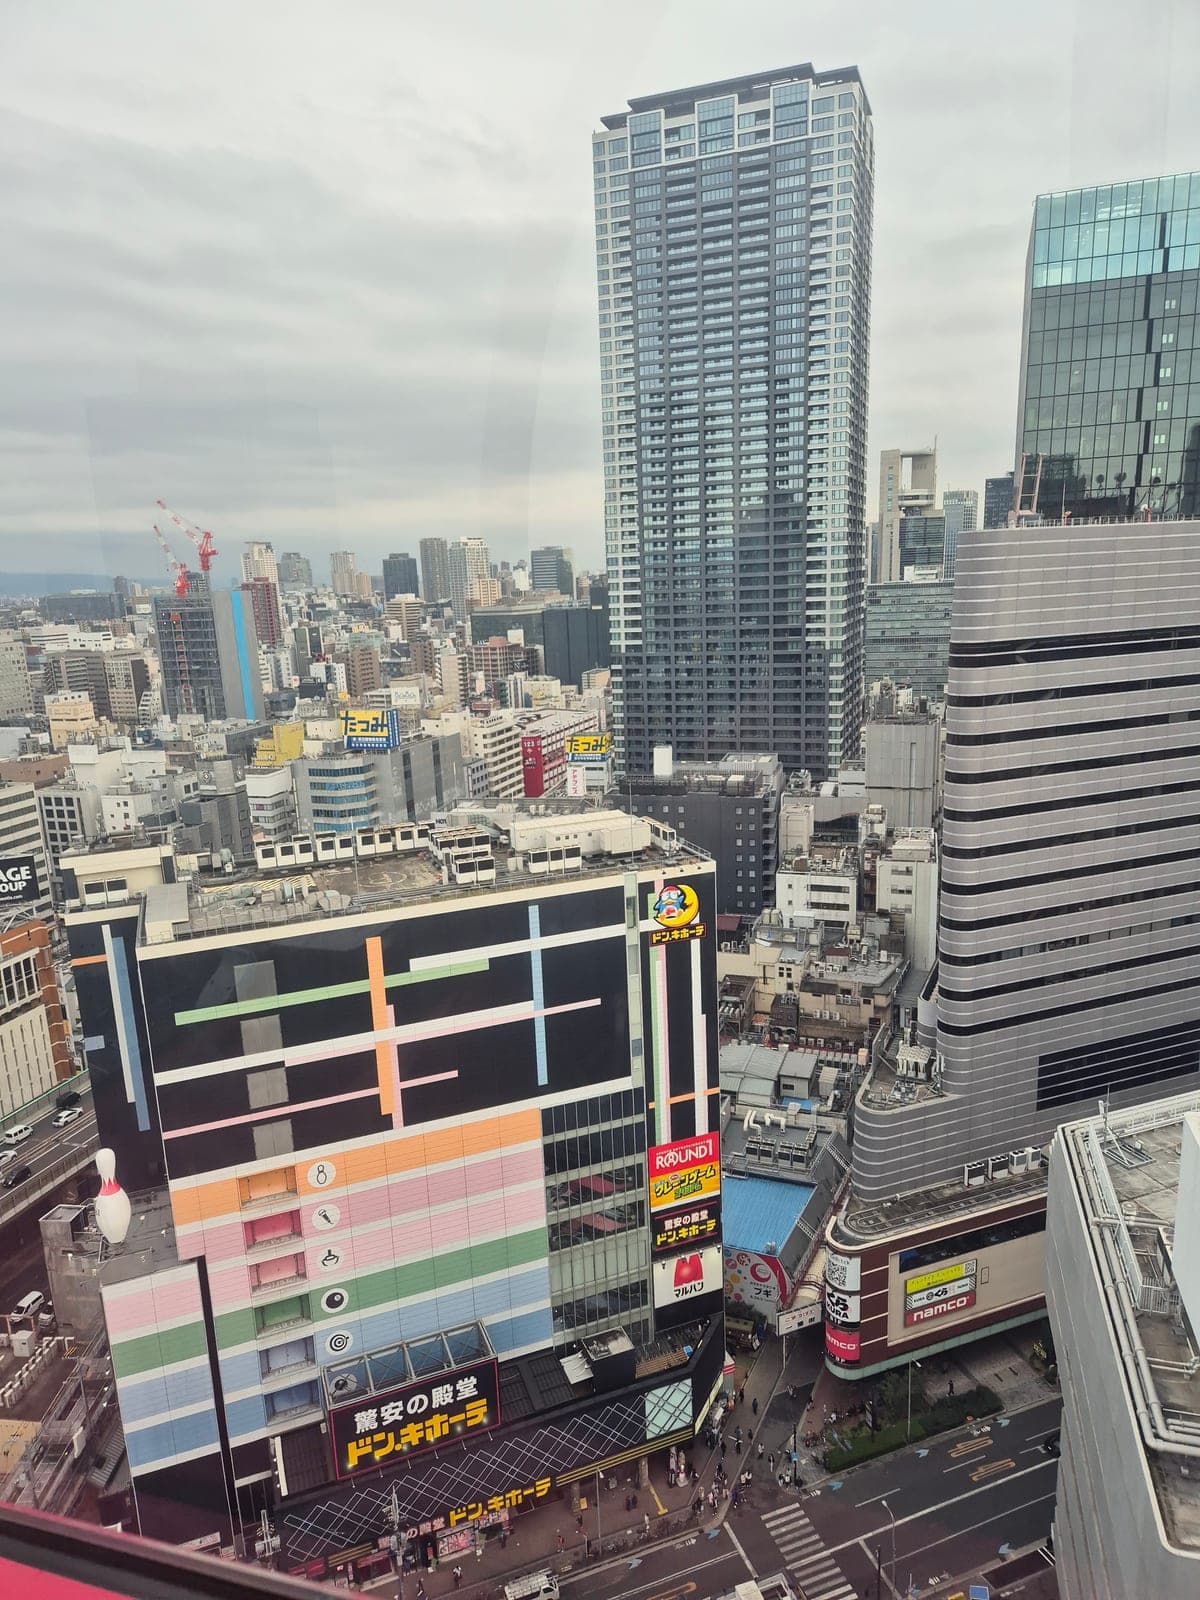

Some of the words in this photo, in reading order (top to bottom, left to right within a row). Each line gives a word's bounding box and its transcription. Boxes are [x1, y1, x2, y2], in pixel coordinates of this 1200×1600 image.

[340, 710, 388, 736] たつみ
[566, 736, 605, 752] たつみ
[655, 1164, 716, 1199] クレーンゲーム
[673, 1281, 704, 1298] マルハン
[913, 1297, 967, 1322] namco
[353, 1375, 479, 1434] 驚安の殿堂
